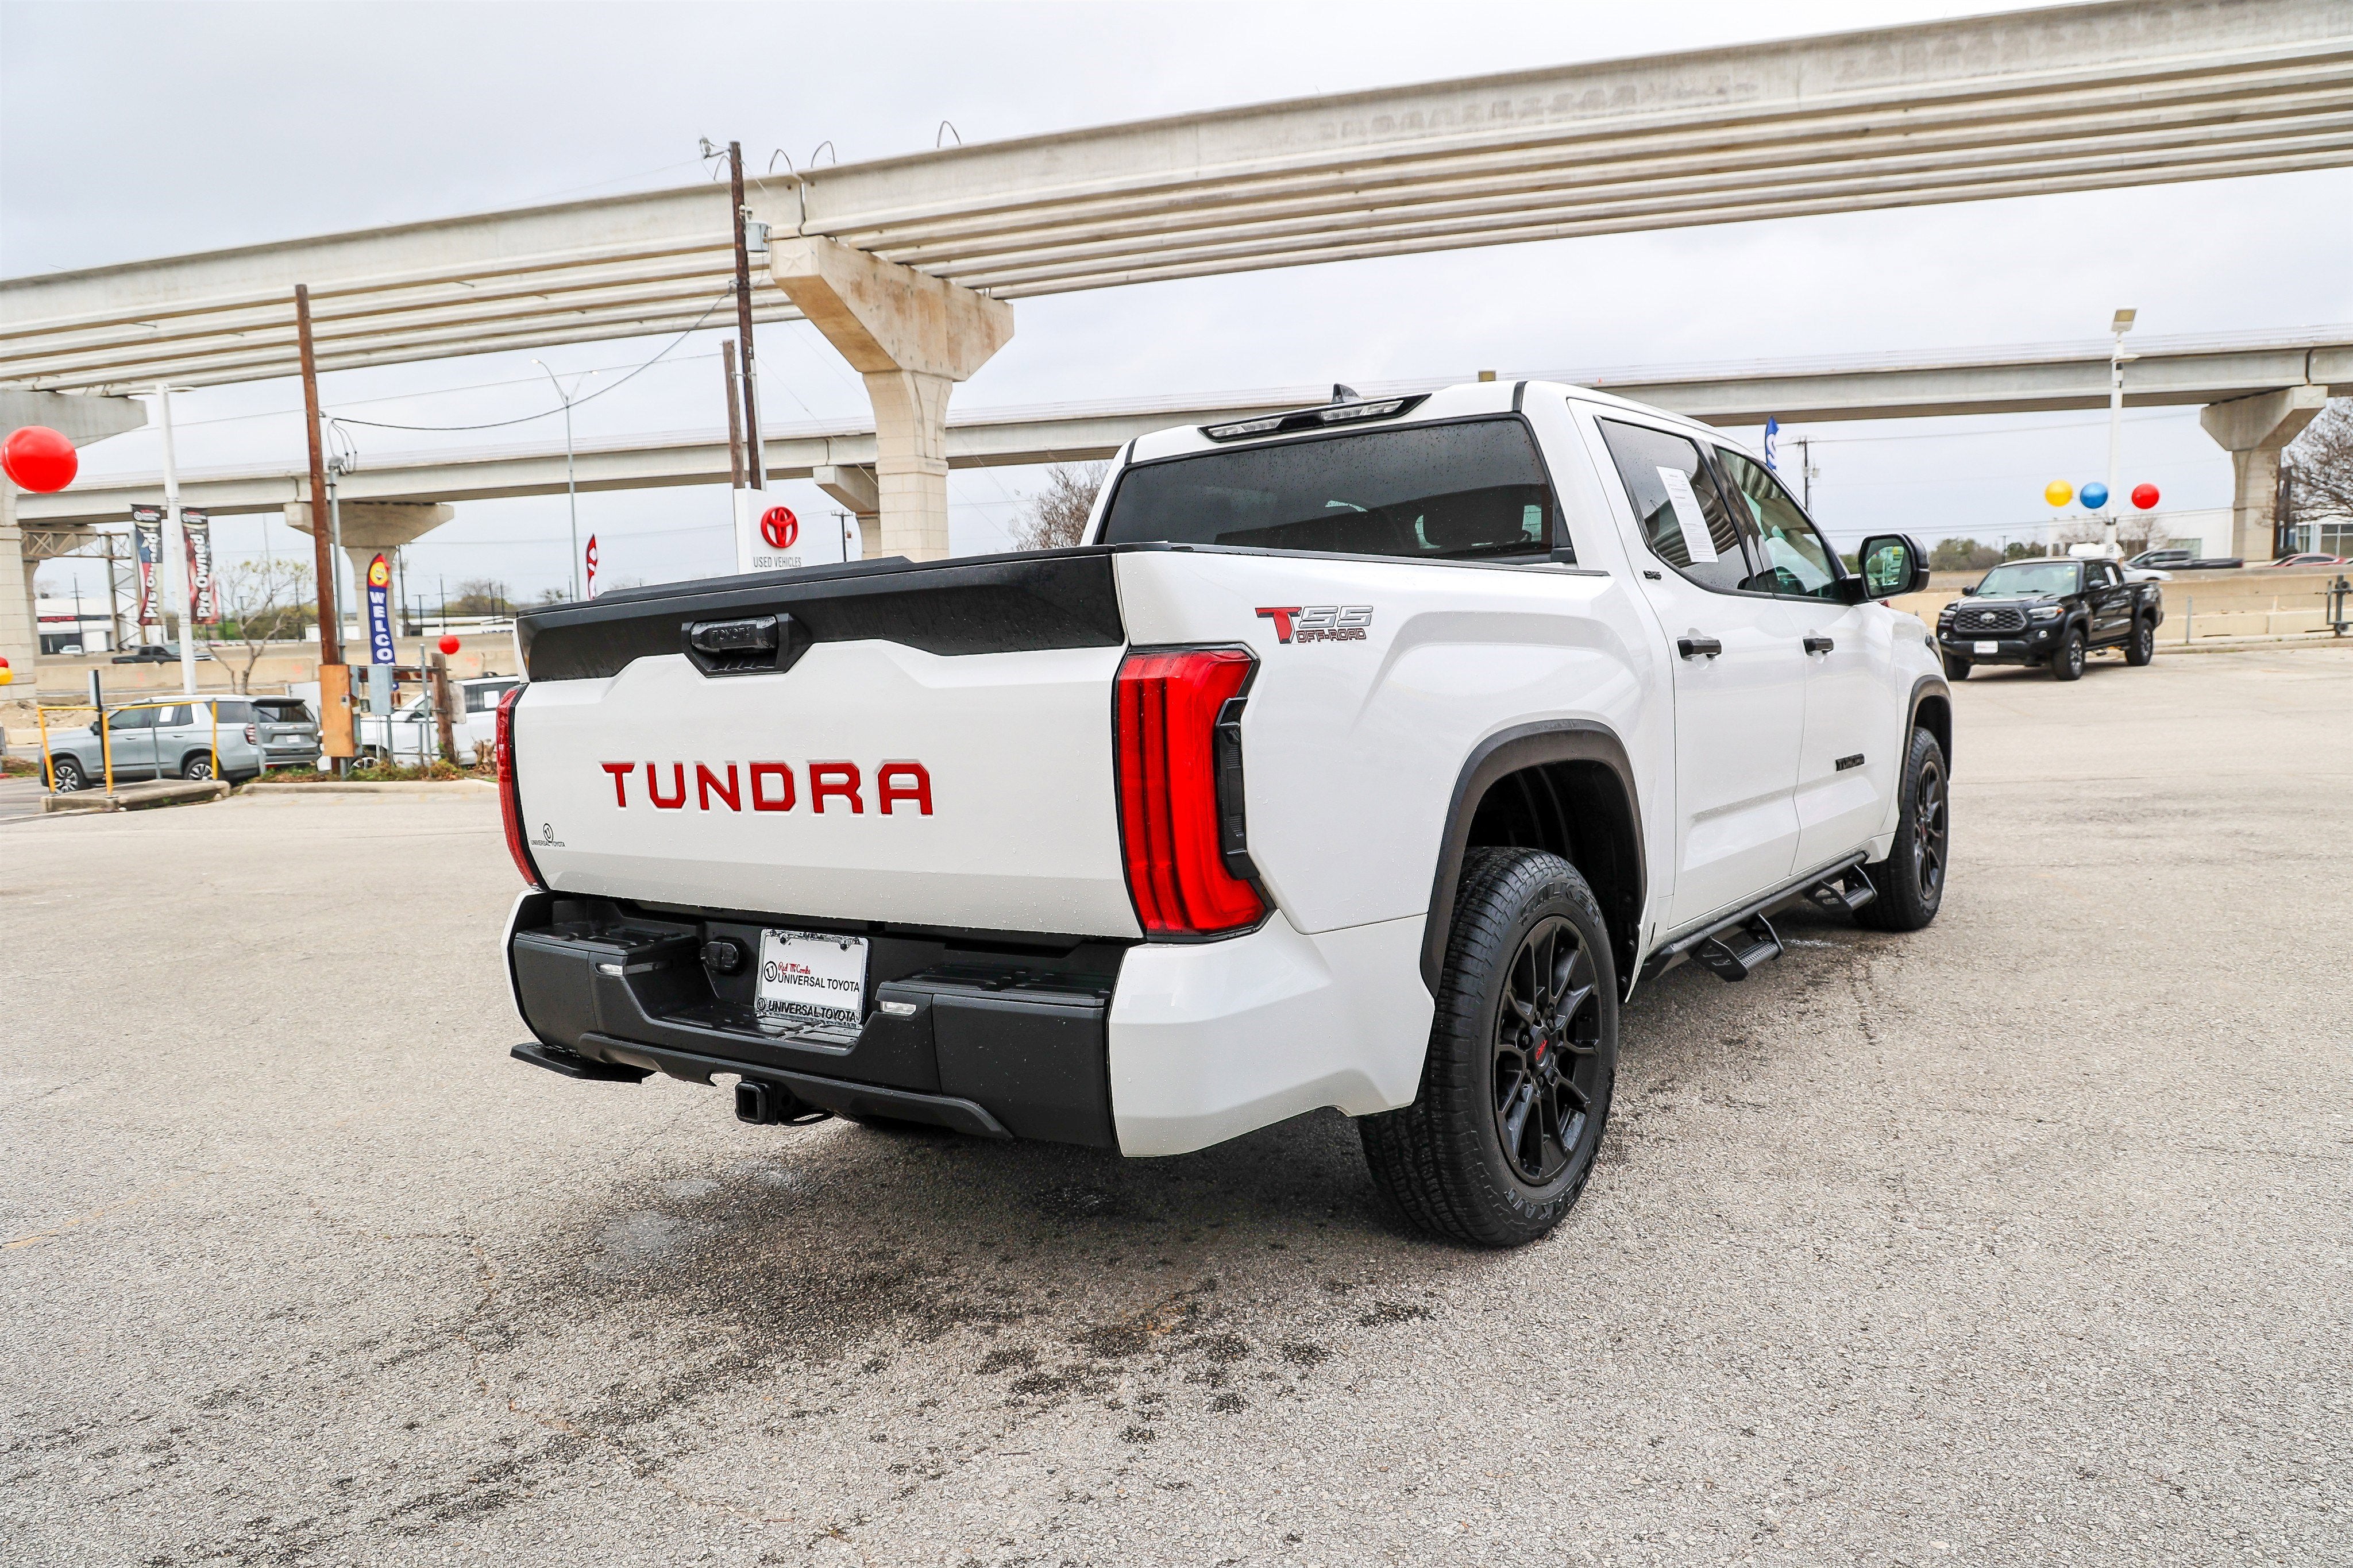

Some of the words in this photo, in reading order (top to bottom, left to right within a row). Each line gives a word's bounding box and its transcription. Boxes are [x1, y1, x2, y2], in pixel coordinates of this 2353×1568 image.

[753, 556, 772, 567] USED
[774, 556, 801, 567] VEHICLES
[369, 591, 396, 666] WELCO
[712, 626, 751, 640] TOYOTA
[1296, 628, 1367, 643] OFF-ROAD
[601, 762, 934, 816] TUNDRA
[778, 961, 788, 975] Red
[778, 973, 826, 988] UNIVERSAL
[827, 979, 860, 992] TOYOTA
[768, 1000, 820, 1017] UNIVERSAL
[821, 1007, 857, 1022] TOYOTA
